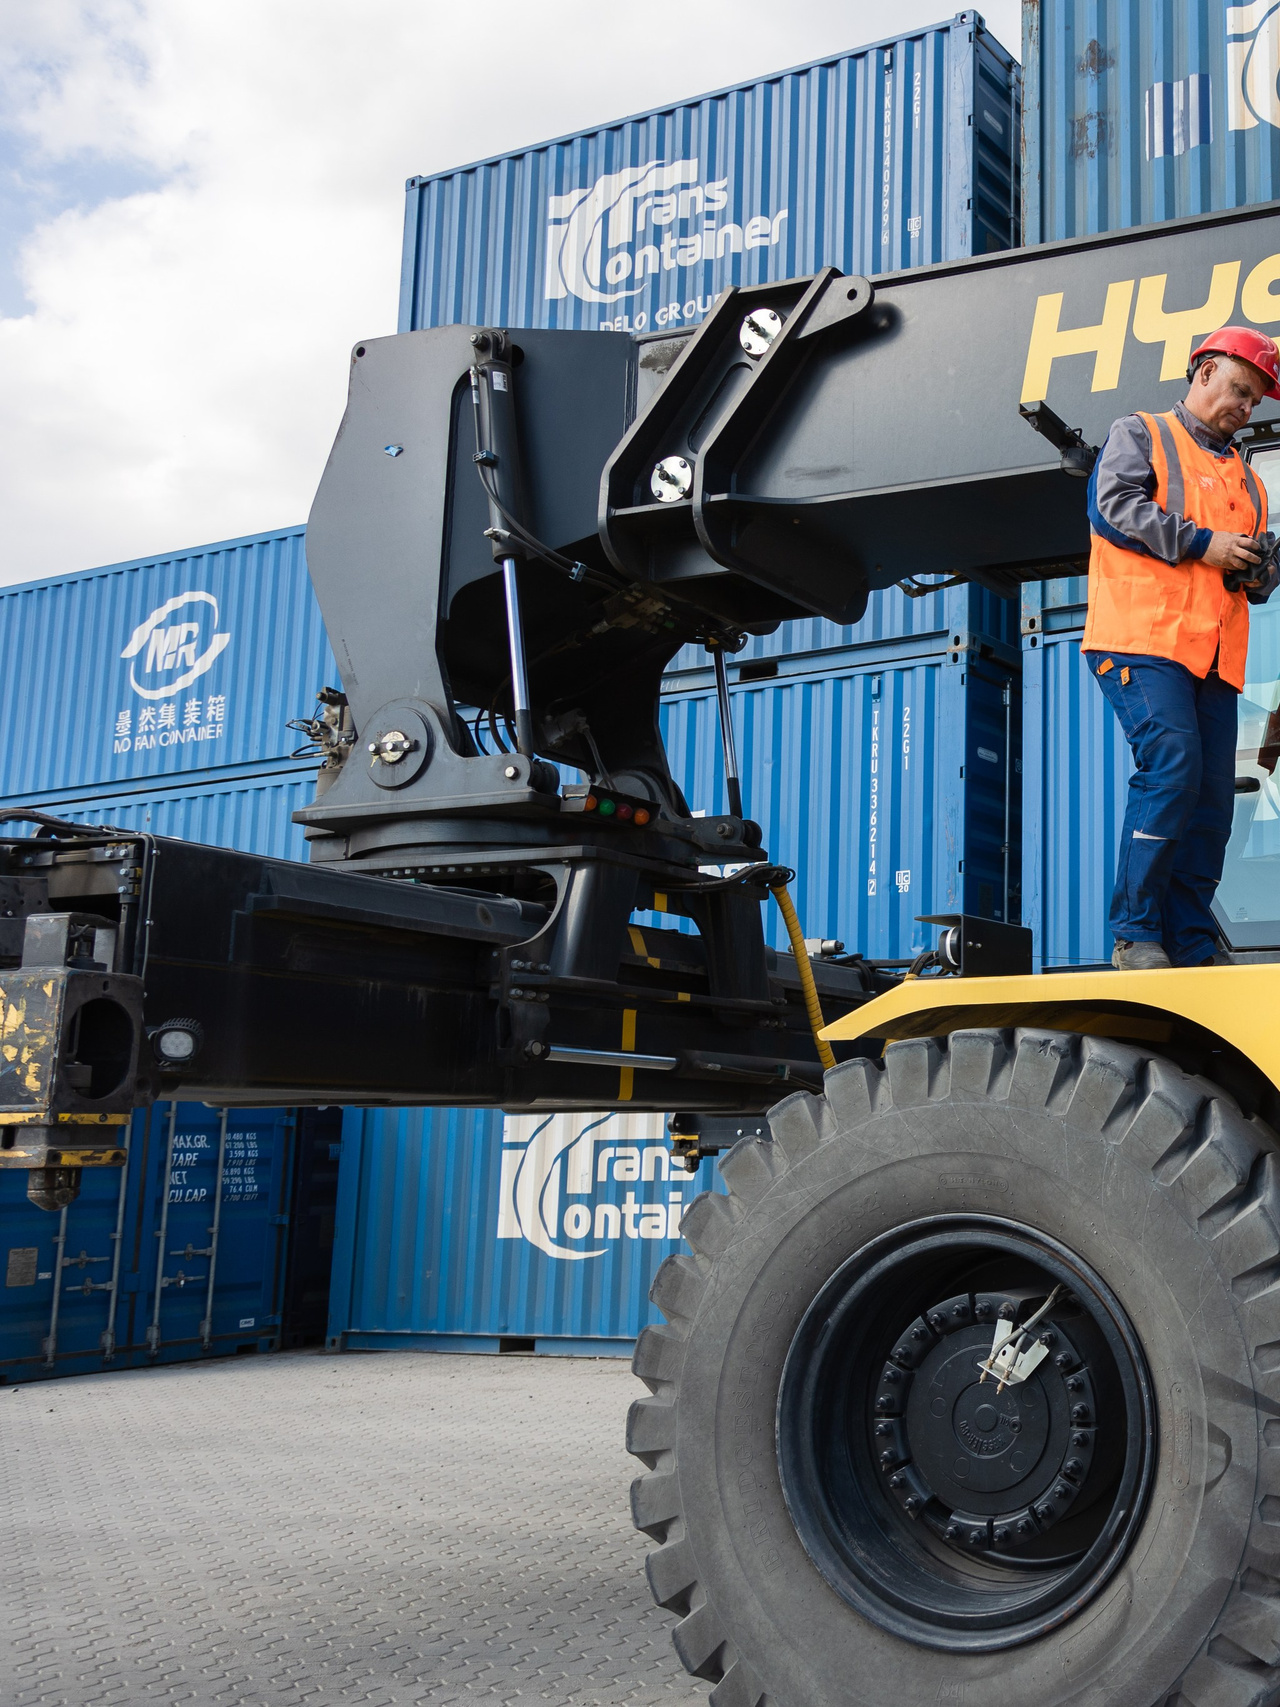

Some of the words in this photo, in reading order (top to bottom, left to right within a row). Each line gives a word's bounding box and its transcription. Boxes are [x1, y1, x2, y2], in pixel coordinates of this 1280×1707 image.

[158, 723, 224, 747] CONTAINER
[902, 707, 911, 770] 22G1
[898, 885, 909, 893] 20
[732, 1287, 790, 1577] BRIDGESTONE
